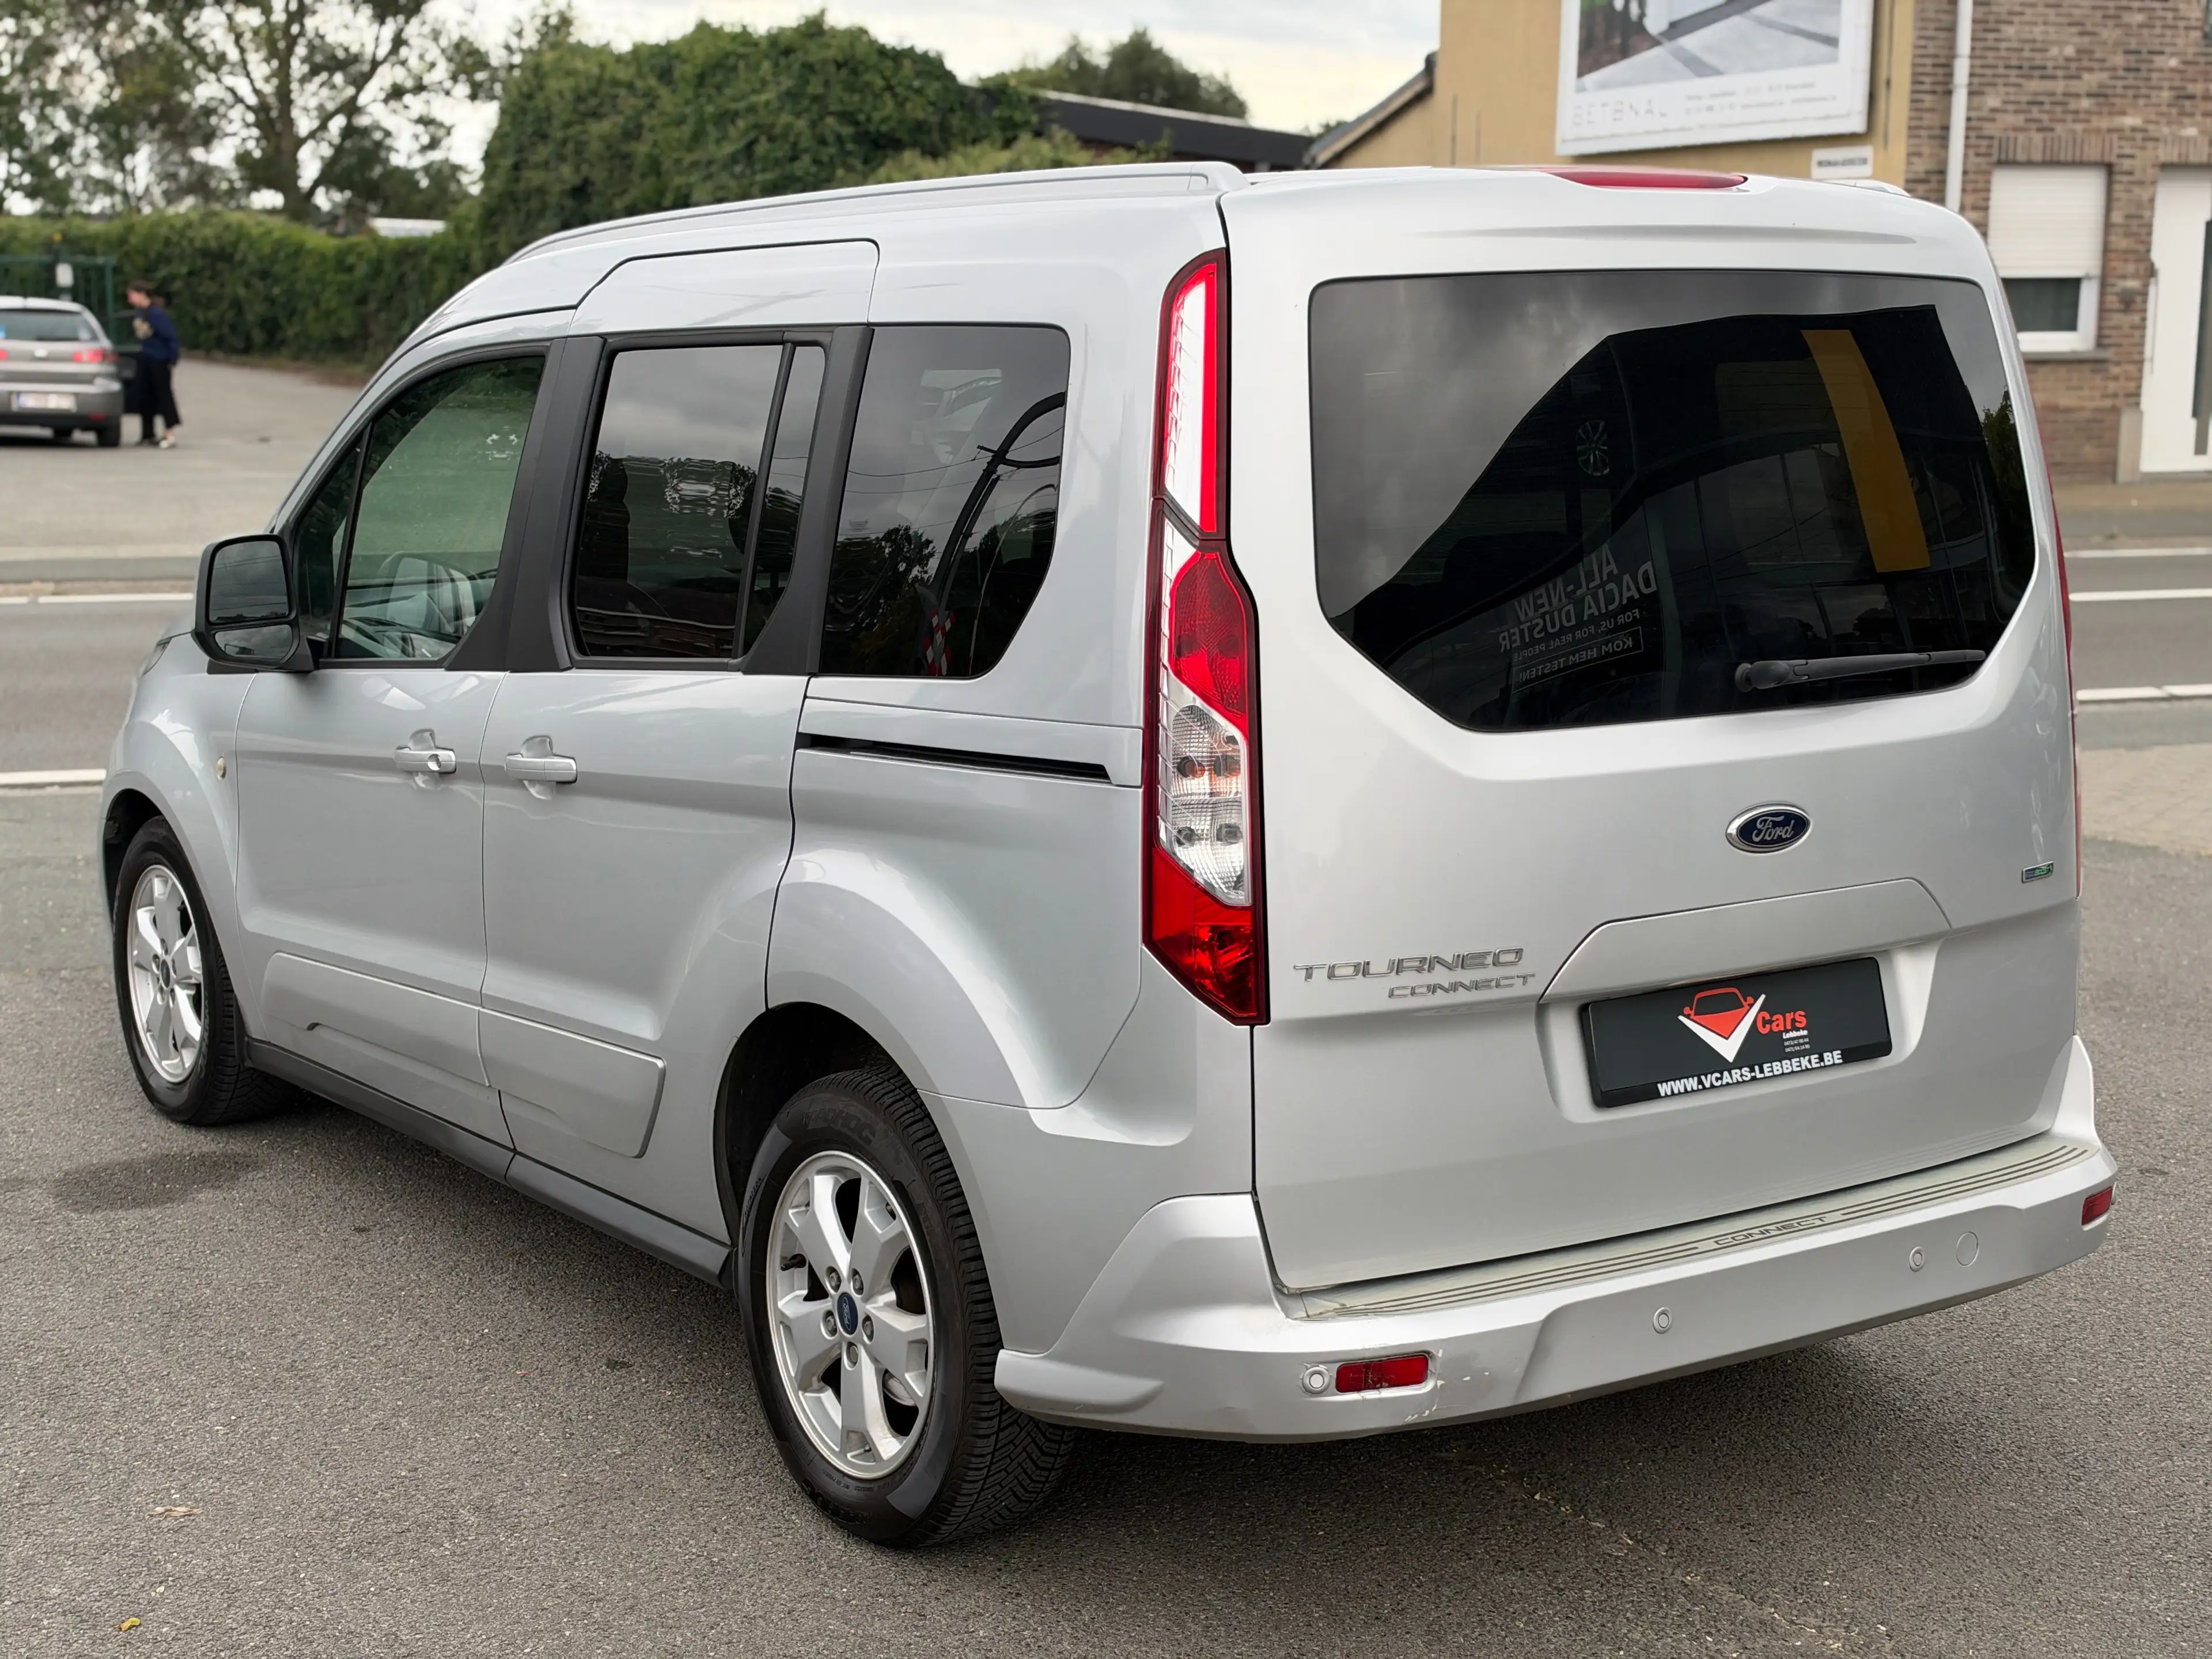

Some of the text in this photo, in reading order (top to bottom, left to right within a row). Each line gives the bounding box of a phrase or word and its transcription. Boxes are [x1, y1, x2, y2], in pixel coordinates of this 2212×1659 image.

[1752, 816, 1795, 842] Ford
[1294, 947, 1524, 982] TOURNEO
[1388, 973, 1535, 998] CONNECT
[1756, 1009, 1806, 1034] Cars
[1782, 1029, 1808, 1039] Lebbeke
[1657, 1050, 1843, 1096] WWW.VCARS-LEBBEKE.BE
[1713, 1217, 1827, 1245] CONNECT
